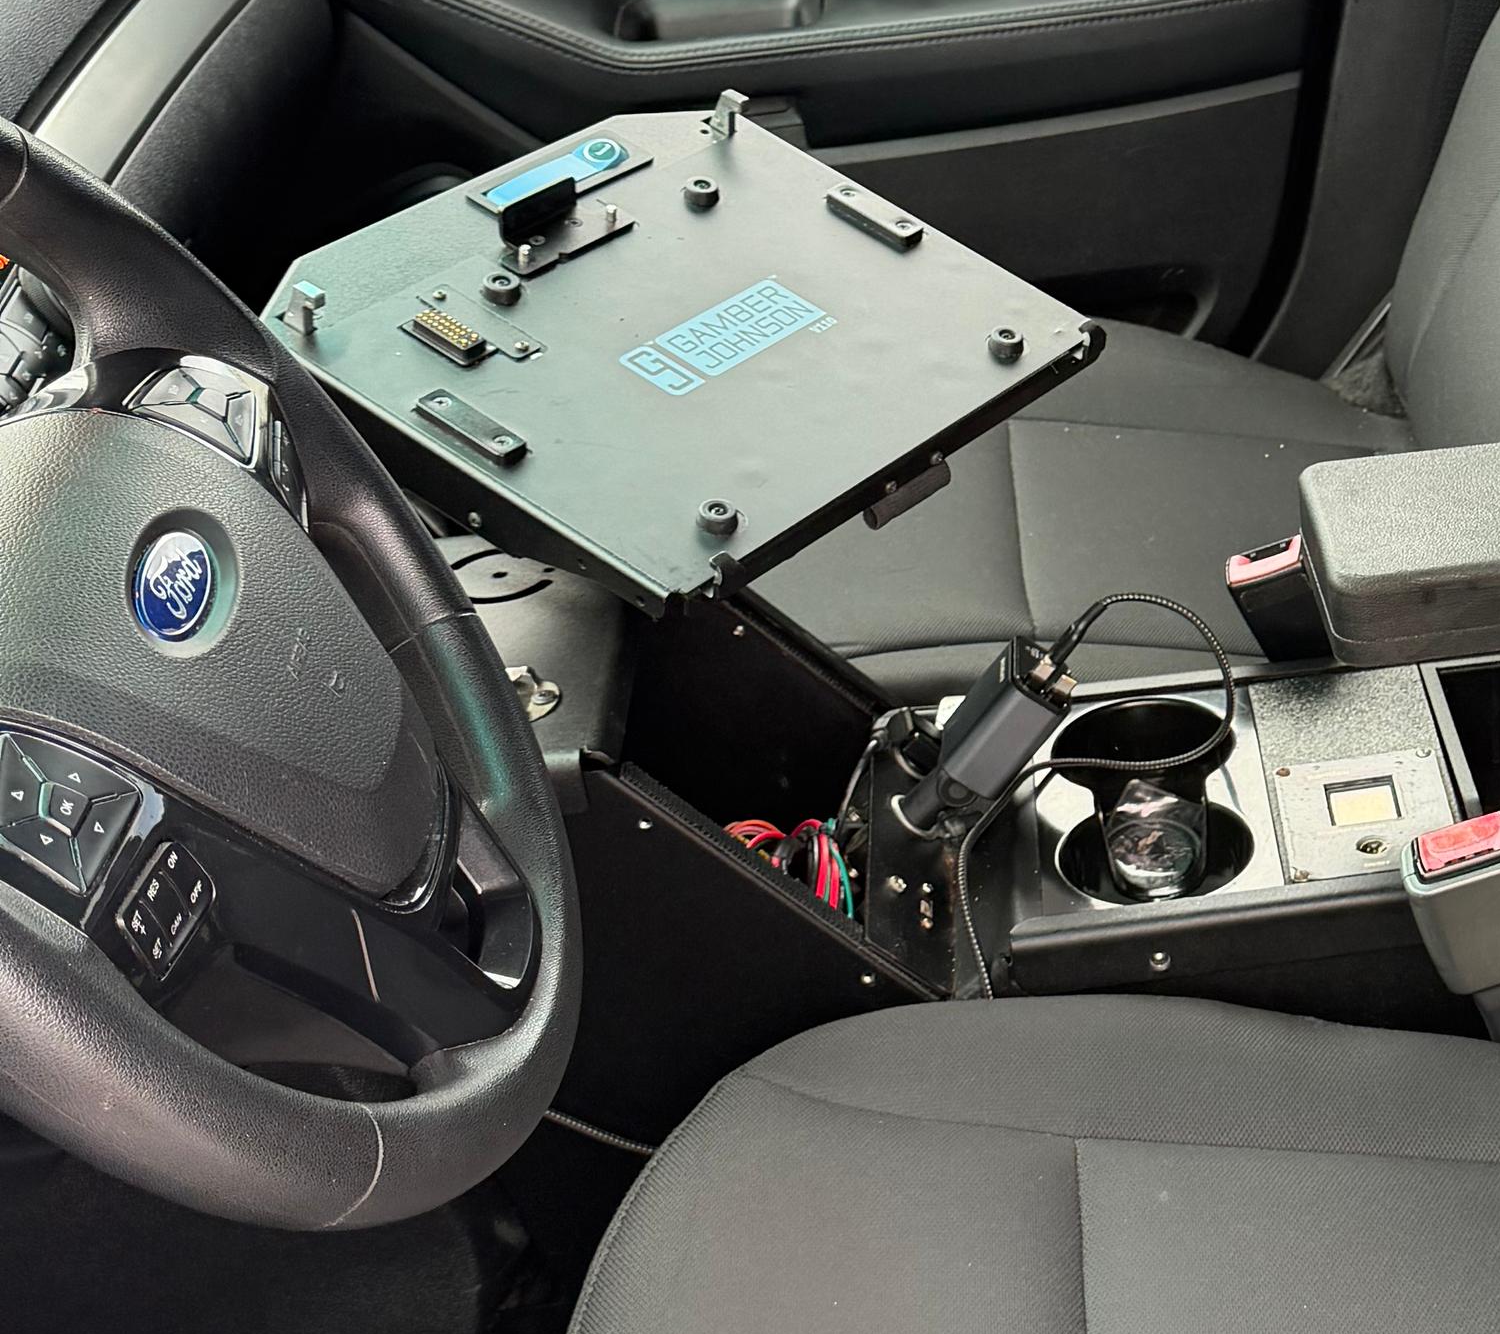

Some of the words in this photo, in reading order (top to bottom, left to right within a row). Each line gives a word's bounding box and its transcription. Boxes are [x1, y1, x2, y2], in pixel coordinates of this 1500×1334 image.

[667, 285, 789, 353] GAMBER
[696, 300, 814, 369] JOHNSON
[147, 547, 203, 620] Ford
[59, 800, 74, 815] OK
[167, 851, 179, 870] ON
[147, 879, 160, 902] RES
[190, 880, 203, 903] OFF
[131, 910, 143, 933] SET
